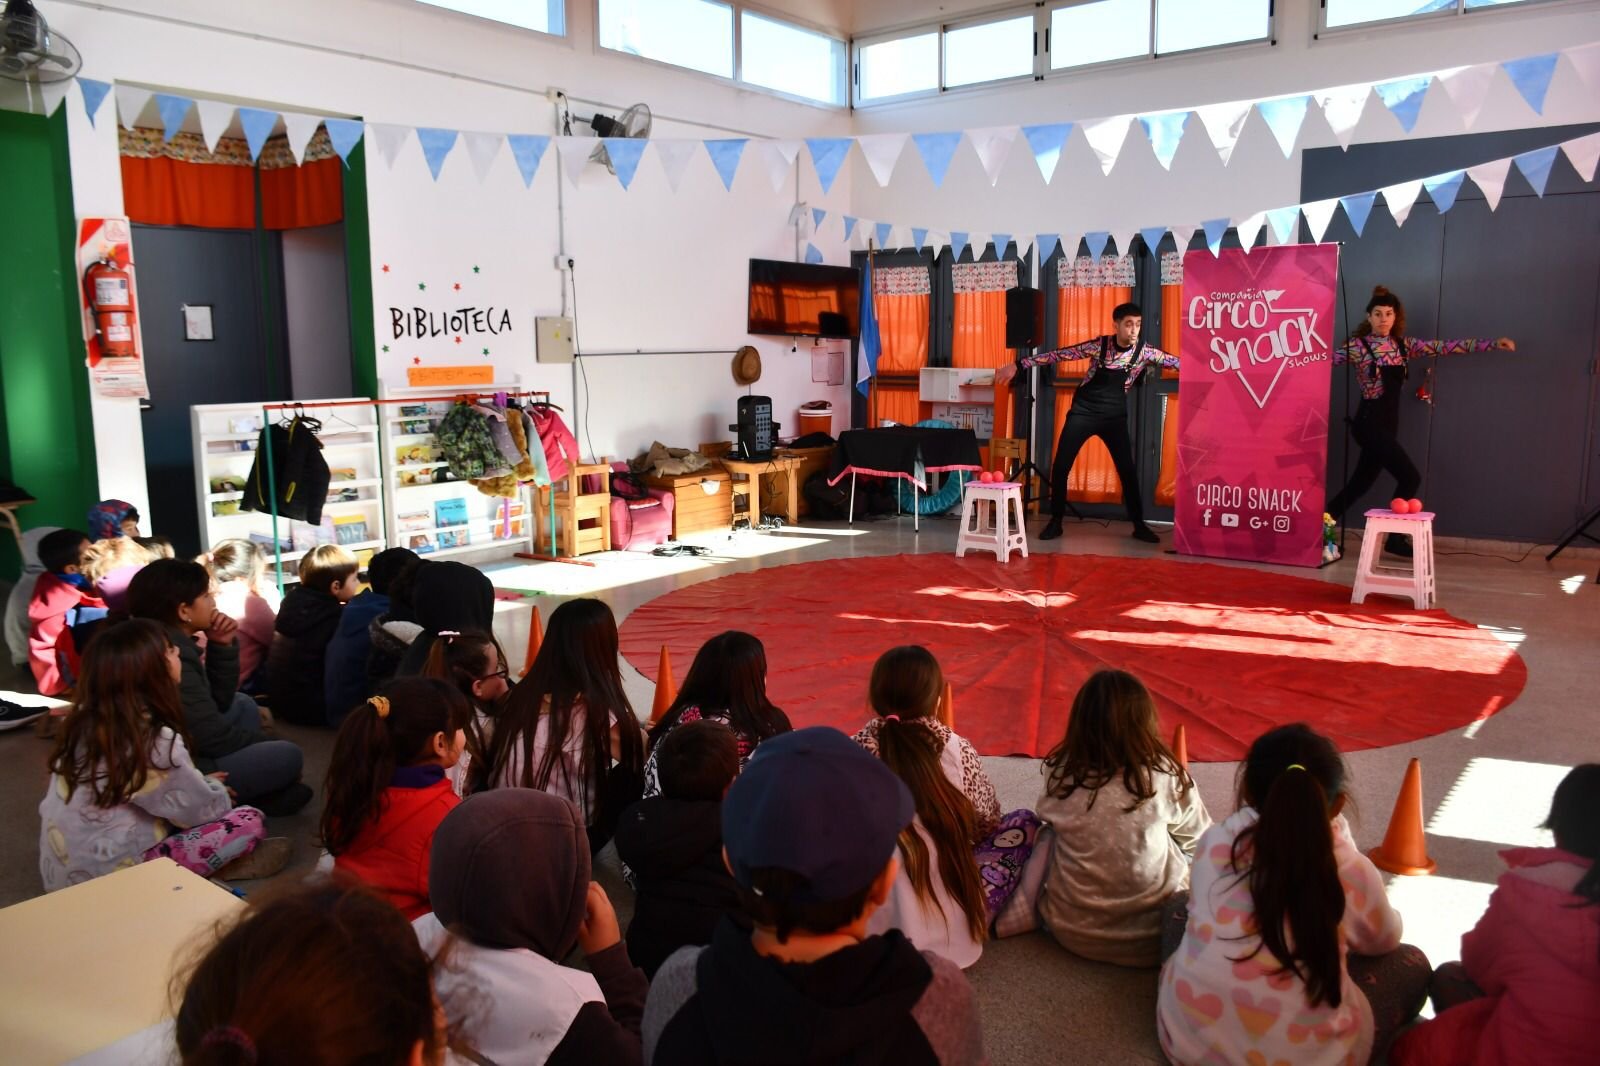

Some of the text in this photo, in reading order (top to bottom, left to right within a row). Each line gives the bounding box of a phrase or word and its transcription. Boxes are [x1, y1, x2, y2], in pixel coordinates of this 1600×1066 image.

[390, 307, 512, 339] BIBLIOTECA
[1188, 295, 1268, 329] Circo
[1197, 483, 1303, 512] CIRCO SNACK
